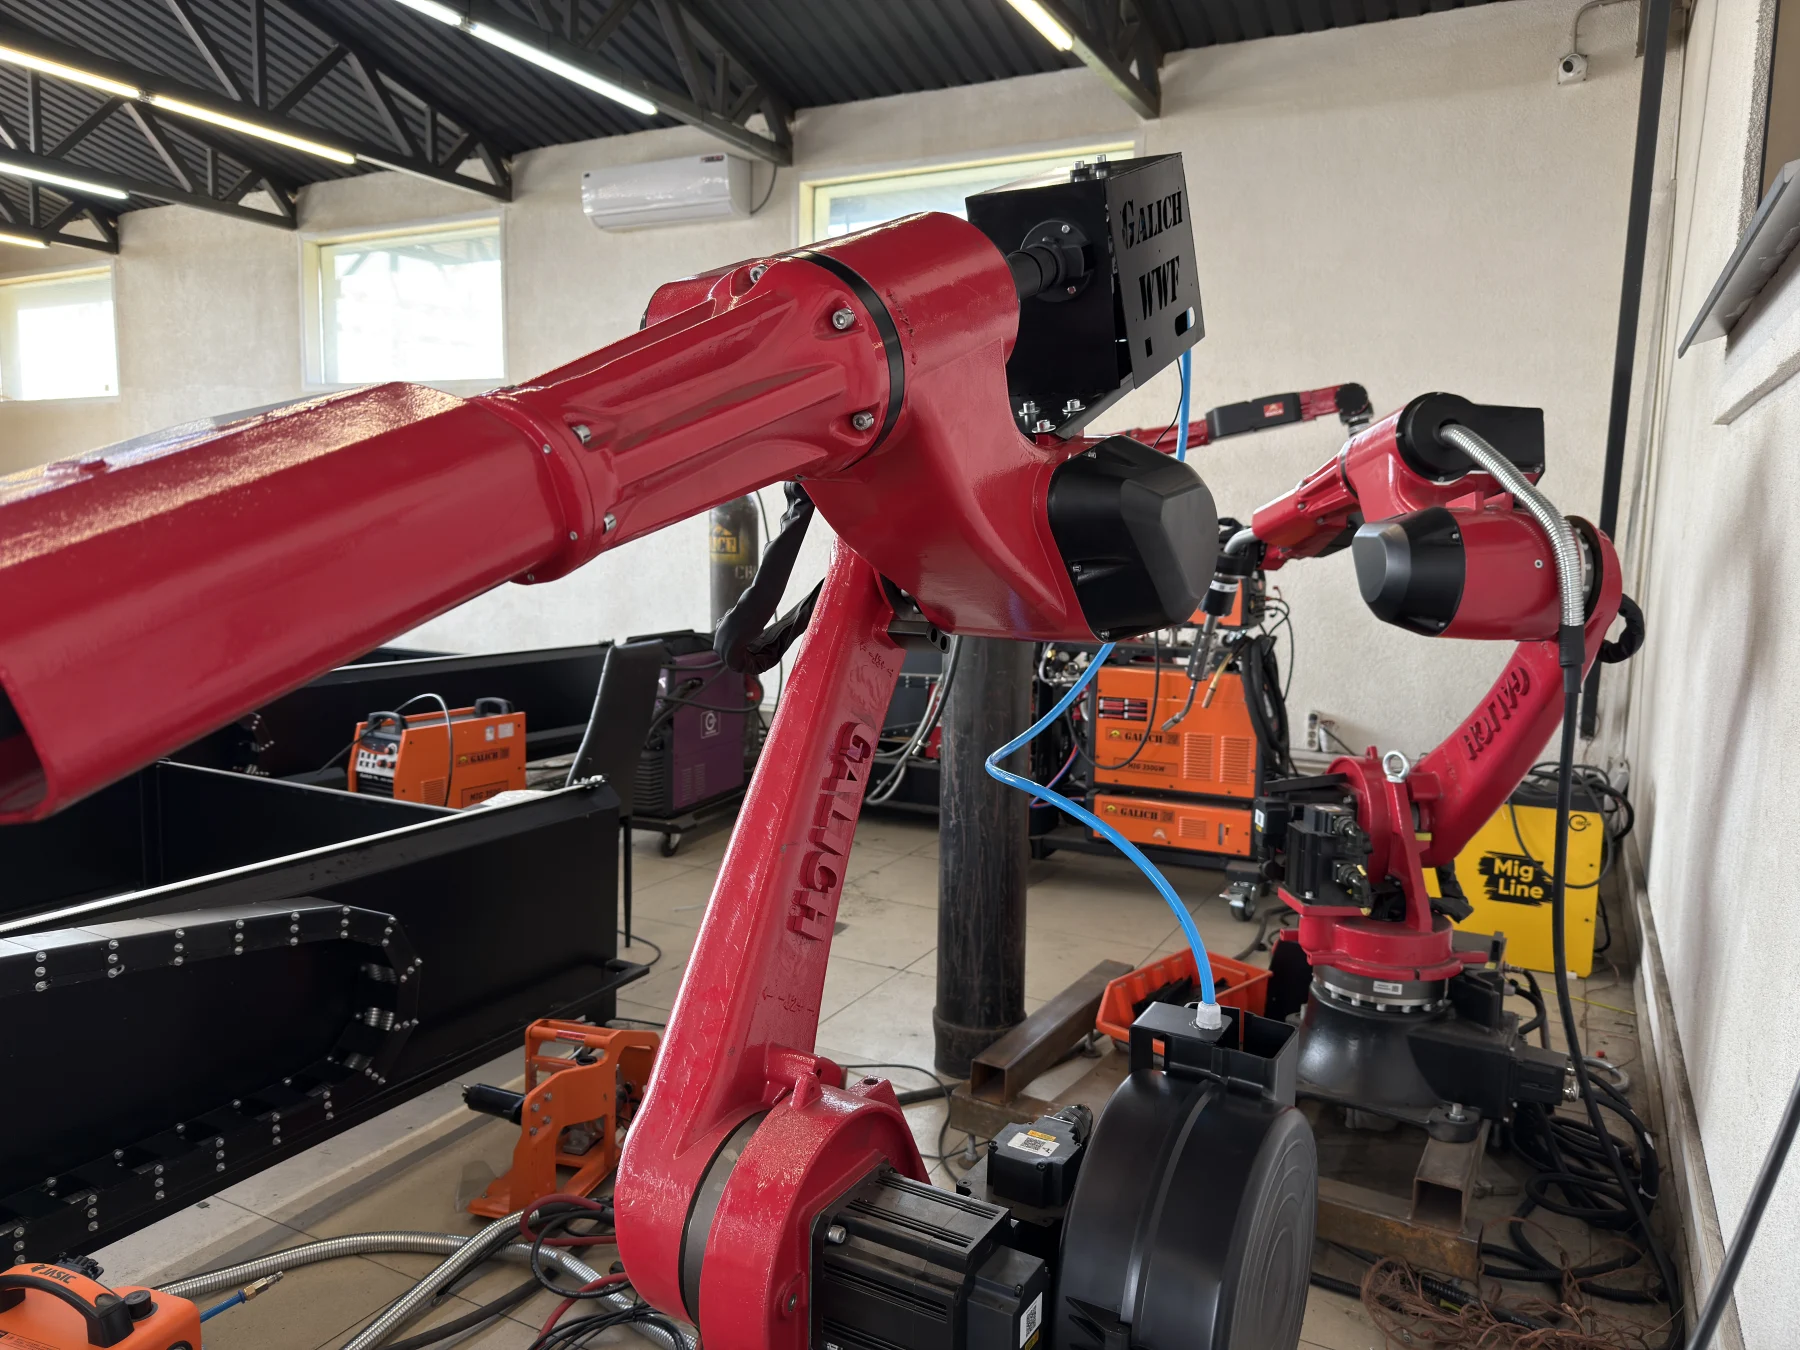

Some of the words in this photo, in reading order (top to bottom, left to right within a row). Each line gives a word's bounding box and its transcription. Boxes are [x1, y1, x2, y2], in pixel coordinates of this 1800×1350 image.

[1120, 190, 1183, 250] GALICH
[1138, 255, 1180, 321] WWF
[1124, 731, 1163, 744] GALCH
[1120, 806, 1159, 820] GALICH
[785, 721, 877, 942] GALICH
[1493, 857, 1535, 883] Mig
[1498, 877, 1544, 899] Line
[38, 1267, 78, 1285] JASIC
